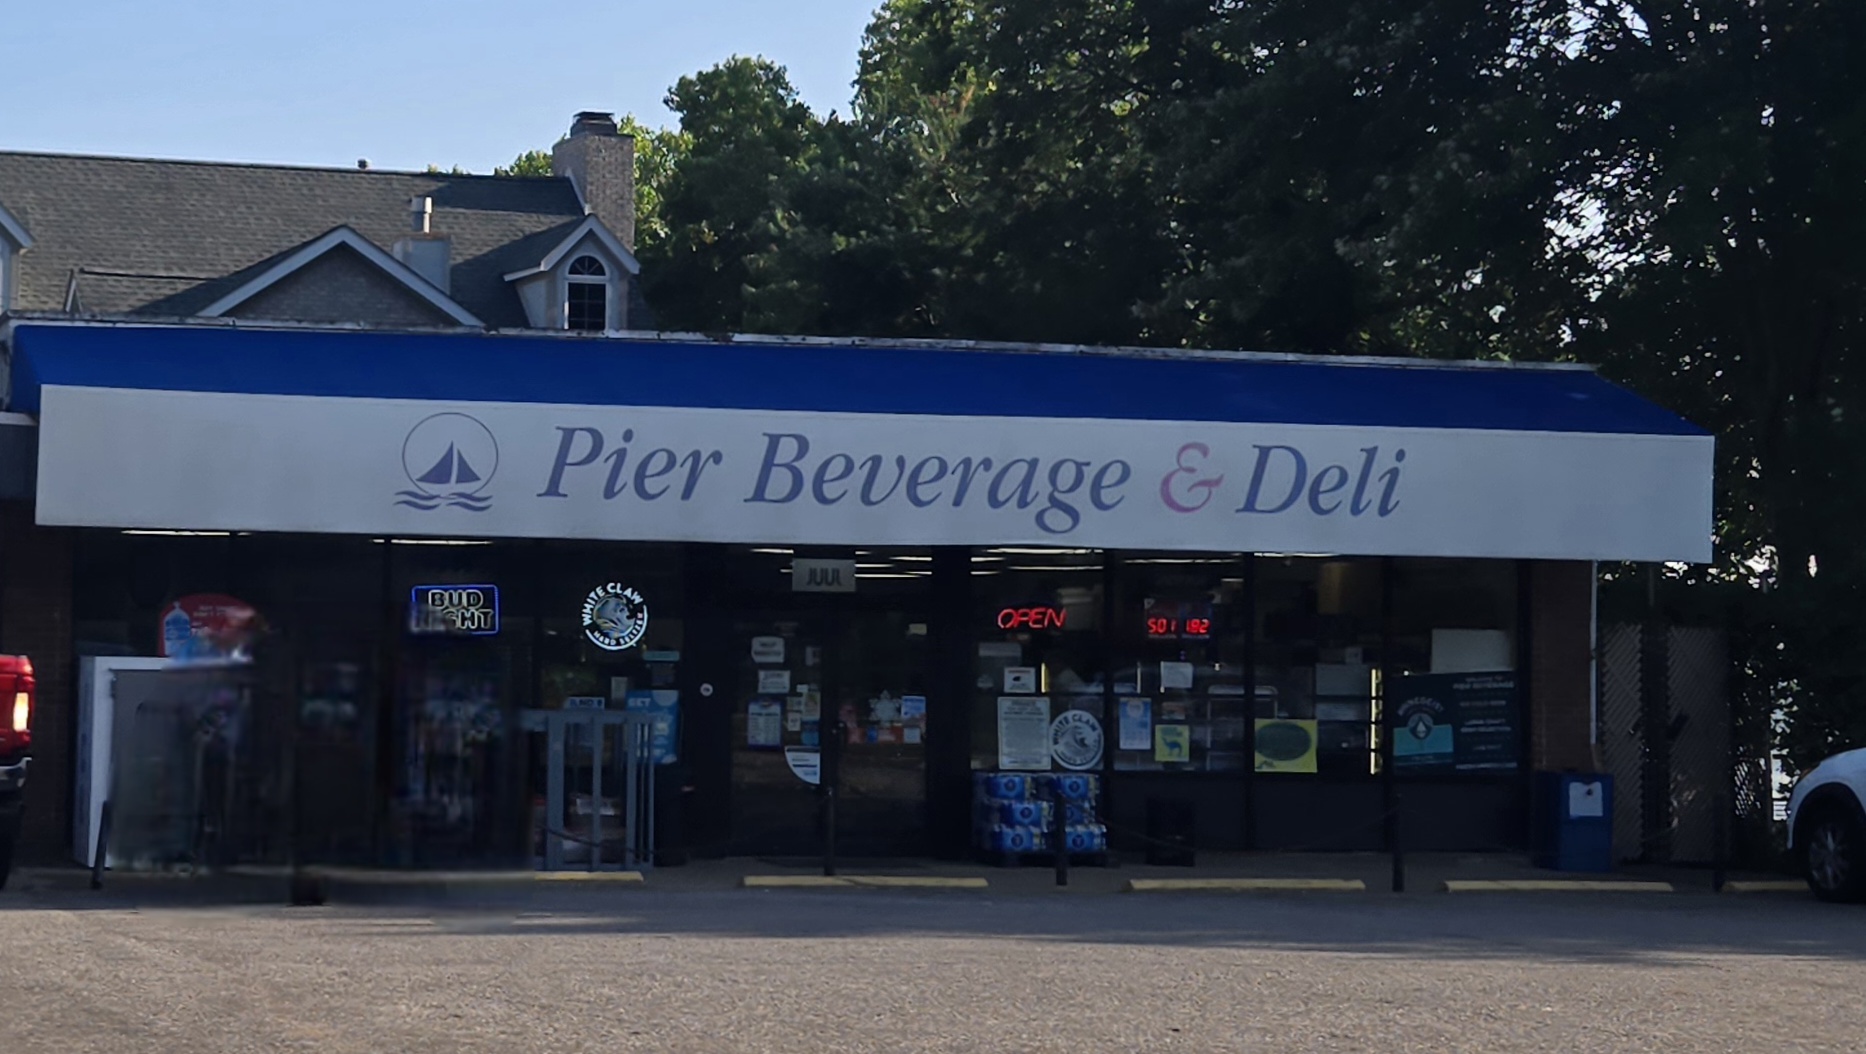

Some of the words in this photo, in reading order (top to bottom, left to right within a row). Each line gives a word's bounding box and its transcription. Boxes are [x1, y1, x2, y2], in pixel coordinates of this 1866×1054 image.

[536, 425, 723, 502] Pier
[744, 432, 1132, 534] Beverage
[1160, 441, 1225, 515] &
[1235, 444, 1406, 518] Deli
[806, 567, 843, 587] JUUL
[428, 588, 484, 610] BUD
[580, 585, 606, 627] WHITE
[606, 582, 644, 605] CLAW
[997, 606, 1068, 630] OPEN
[1071, 713, 1098, 732] CLAW
